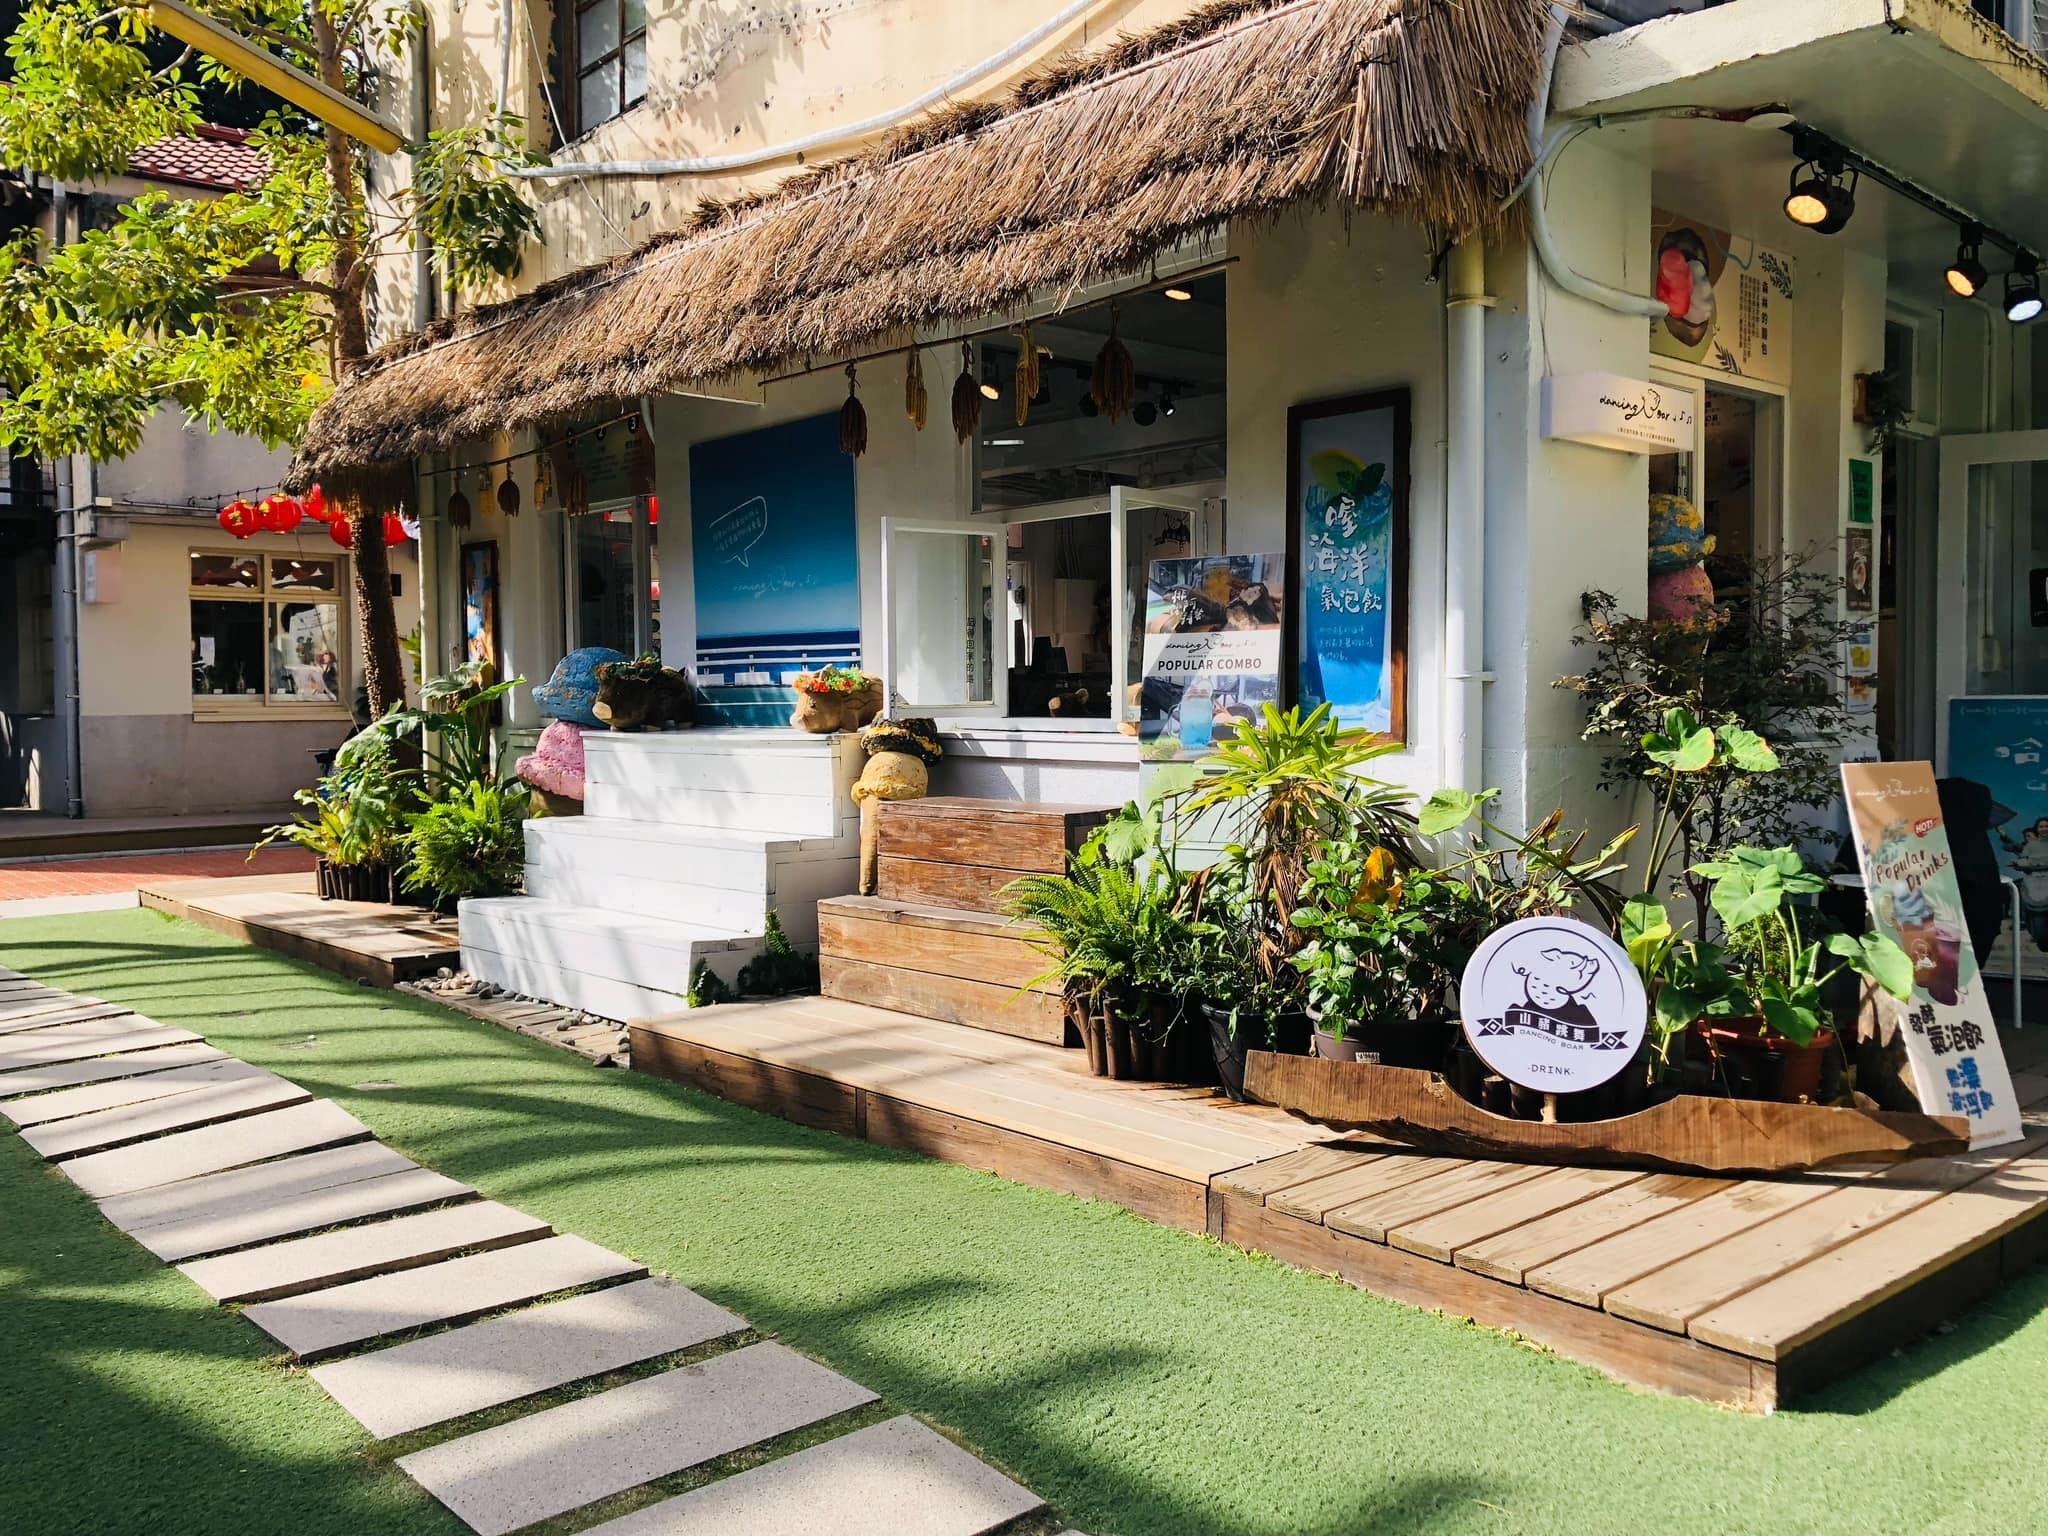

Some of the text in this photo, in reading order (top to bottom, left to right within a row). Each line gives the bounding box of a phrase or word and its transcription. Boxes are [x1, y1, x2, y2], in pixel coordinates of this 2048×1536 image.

[1309, 533, 1371, 586] 海洋
[1320, 585, 1382, 614] 氣泡飲
[1158, 658, 1262, 671] POPULAR COMBO
[1876, 850, 1925, 884] Popular
[1905, 852, 1949, 893] Drinks
[1520, 1029, 1584, 1051] DANCING BOAR
[1926, 1020, 1985, 1056] 氣泡飲
